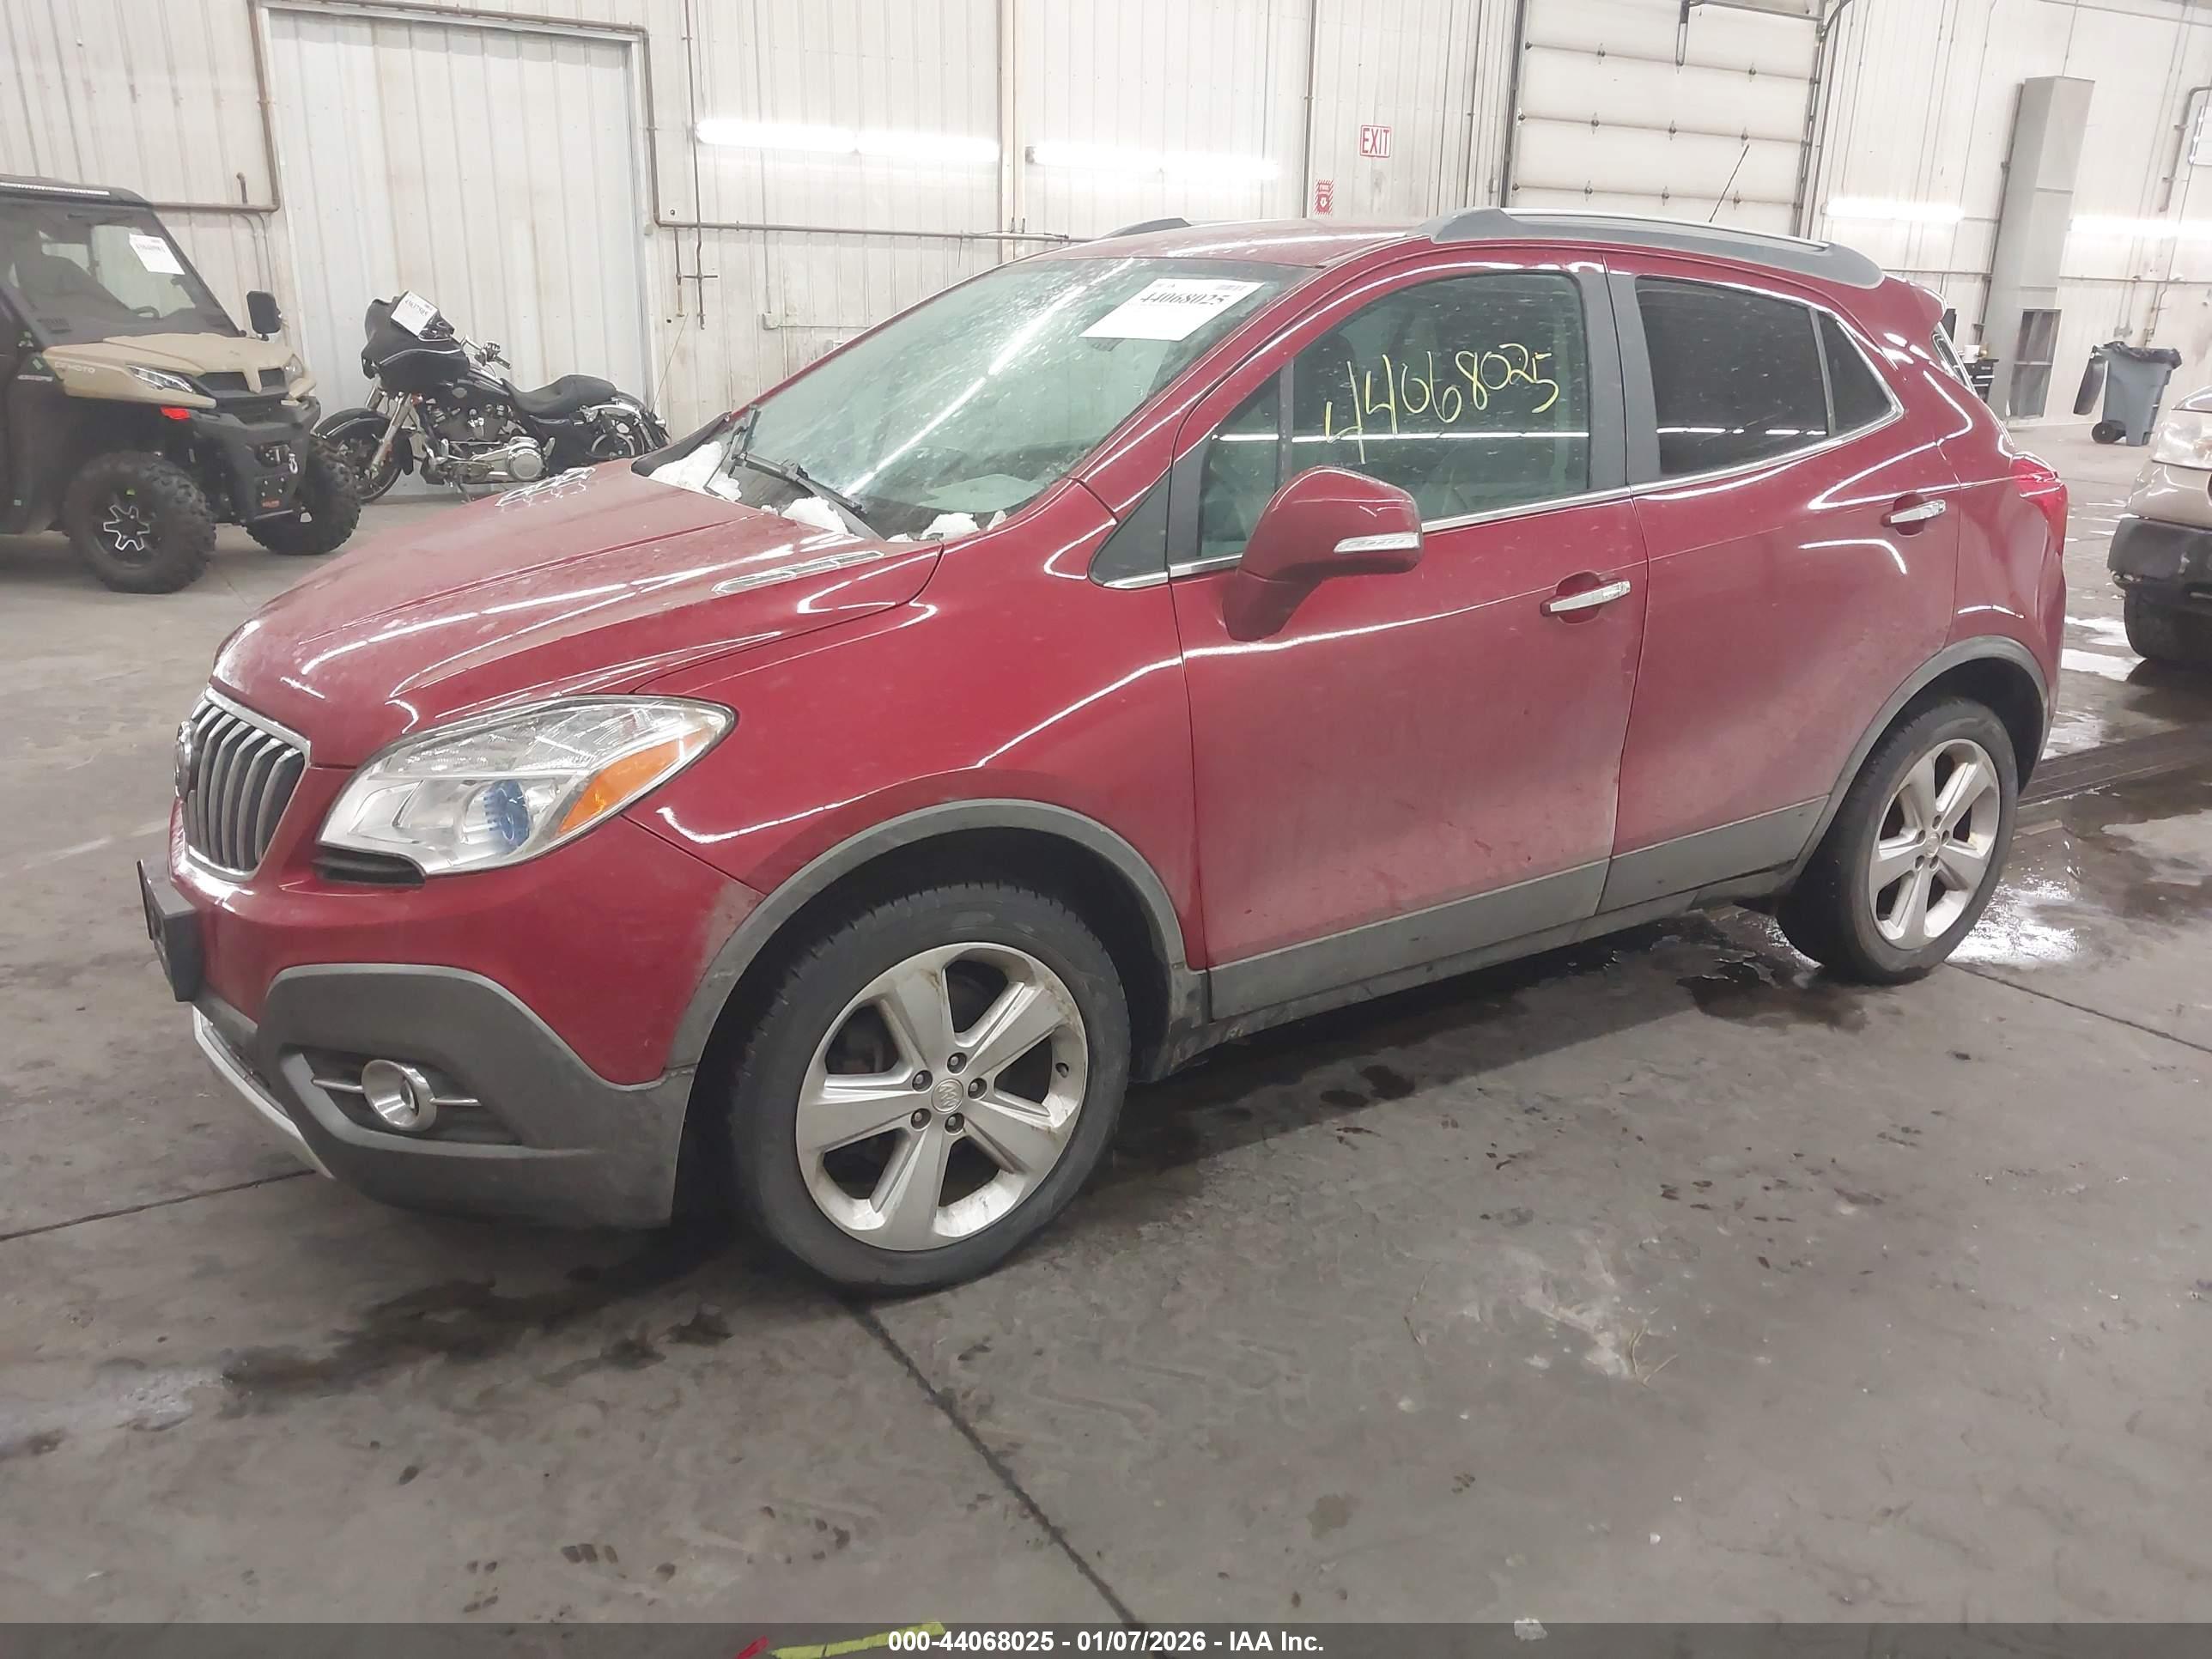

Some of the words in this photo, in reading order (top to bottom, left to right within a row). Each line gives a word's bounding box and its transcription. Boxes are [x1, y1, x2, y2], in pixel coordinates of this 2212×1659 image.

[1362, 128, 1389, 155] EXIT
[1140, 292, 1231, 305] 44068025
[1325, 343, 1559, 465] 44068025
